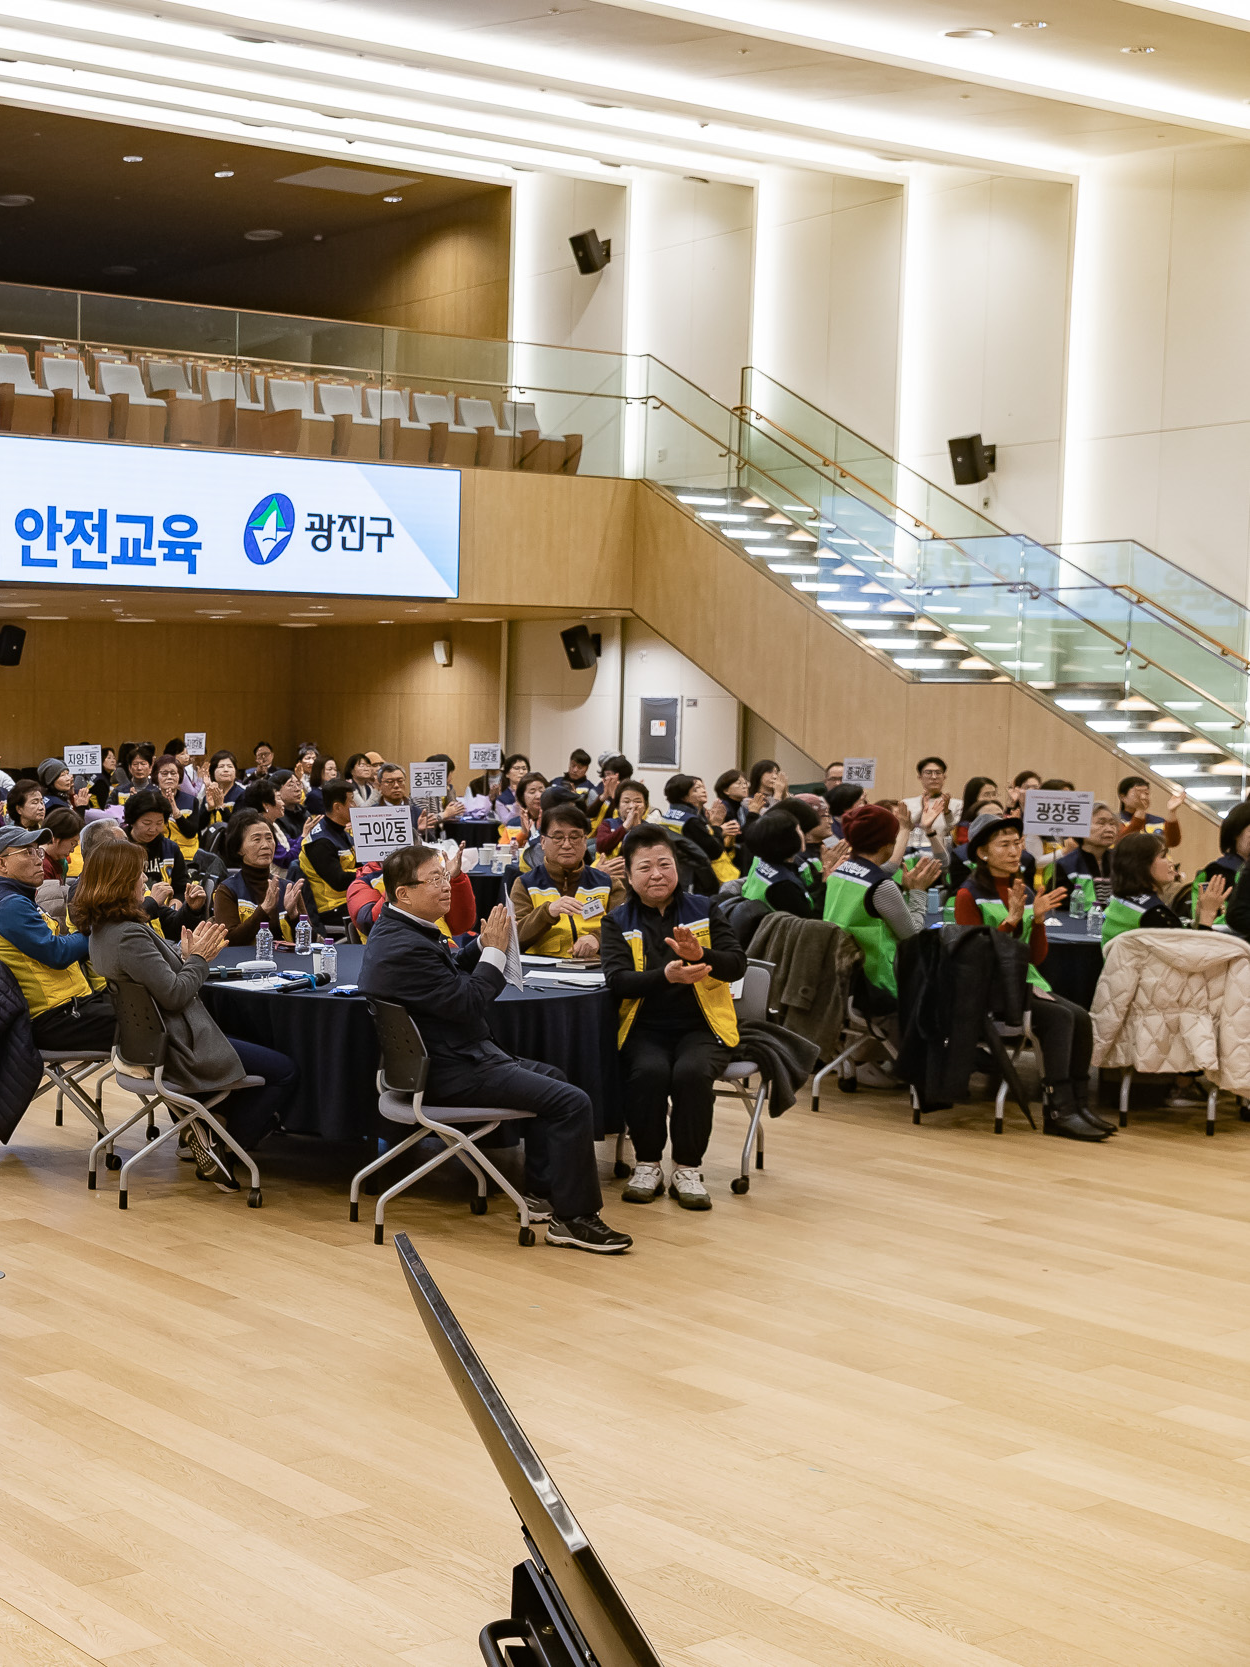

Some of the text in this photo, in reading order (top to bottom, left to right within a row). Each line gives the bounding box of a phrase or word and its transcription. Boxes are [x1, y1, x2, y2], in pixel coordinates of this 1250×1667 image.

[14, 505, 203, 575] 안전교육
[304, 512, 395, 554] 광진구
[67, 753, 98, 765] 자양1동
[414, 771, 443, 787] 중곡3동
[1036, 802, 1081, 823] 광장동
[358, 821, 407, 844] 구의2동
